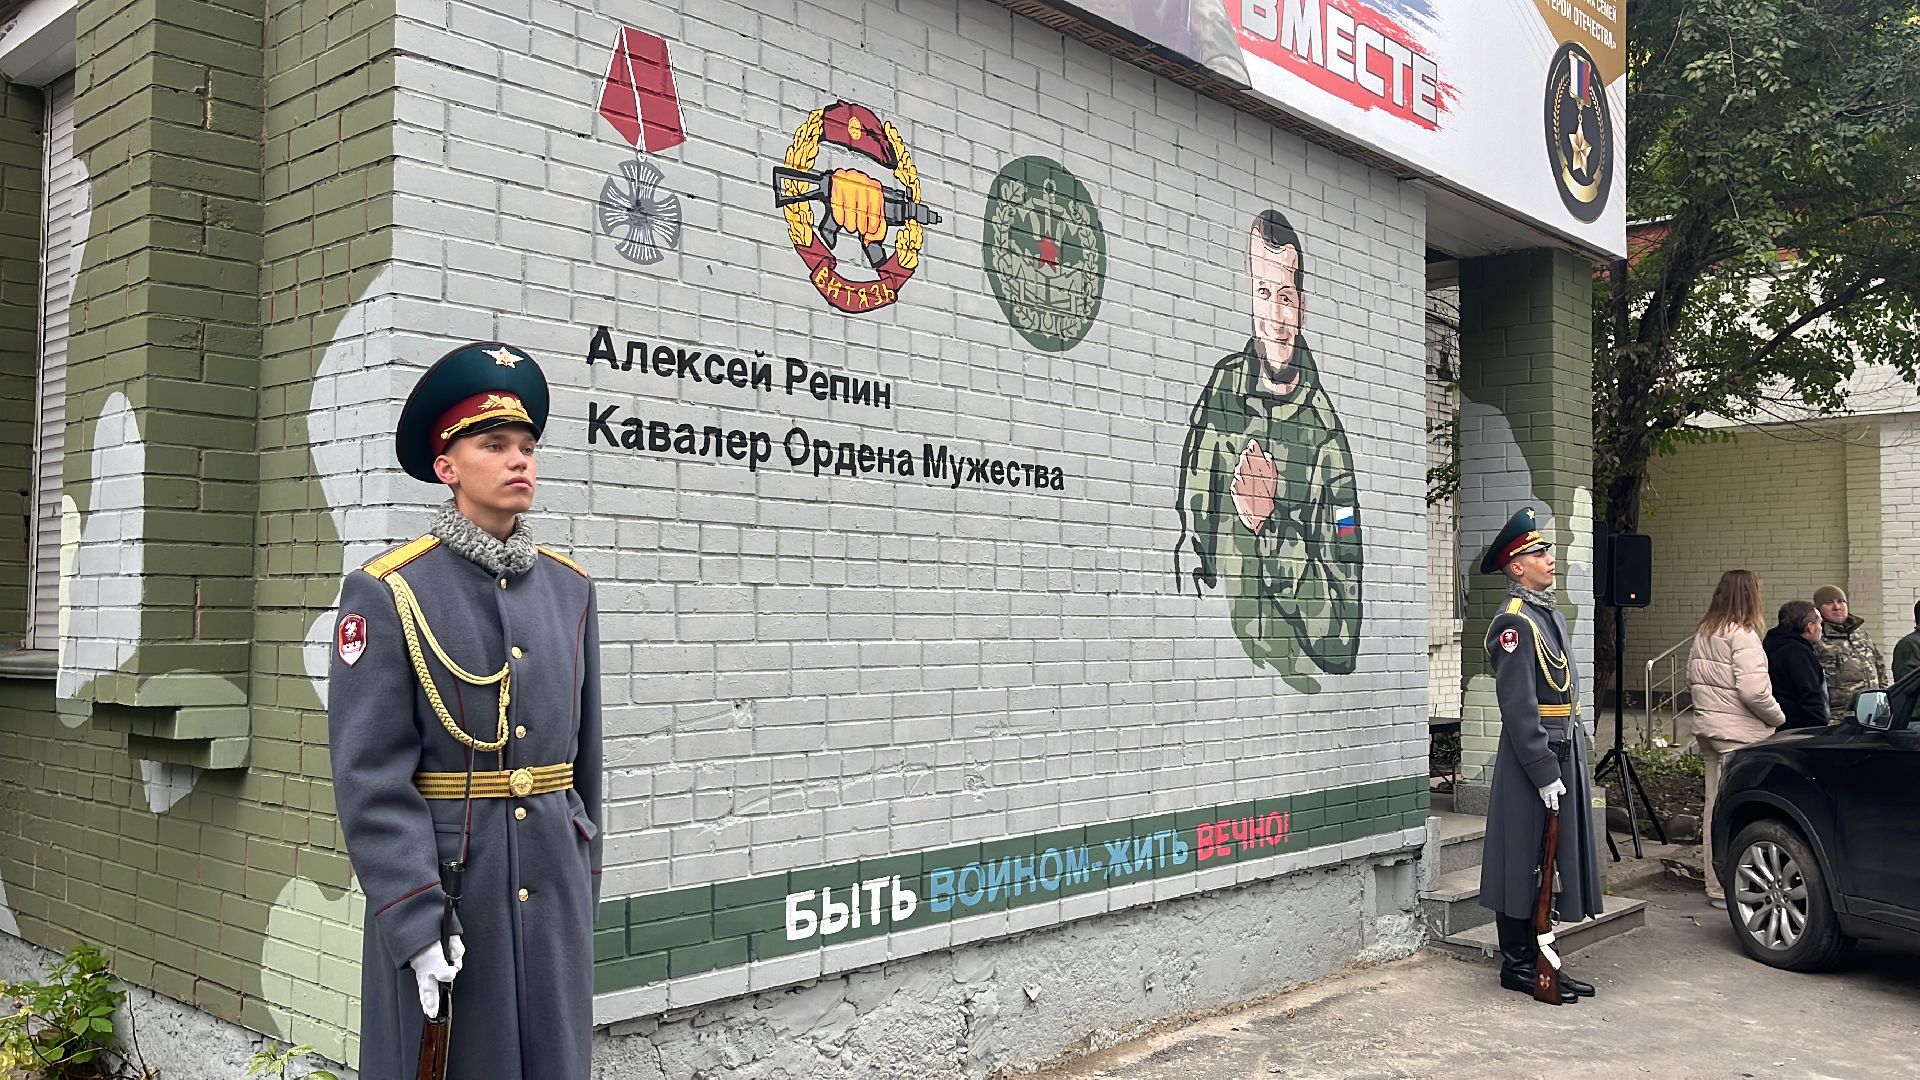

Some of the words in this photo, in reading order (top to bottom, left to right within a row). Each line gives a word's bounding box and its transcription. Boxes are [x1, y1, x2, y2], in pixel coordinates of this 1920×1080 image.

[815, 266, 895, 308] ВИТЯЗЬ
[586, 325, 772, 394] Алексей
[785, 357, 892, 410] Репин
[587, 401, 772, 473] Кавалер
[782, 426, 915, 478] Ордена
[922, 443, 1065, 491] Мужества
[785, 875, 917, 941] БЫТЬ
[1196, 811, 1290, 862] ВЕЧНО!
